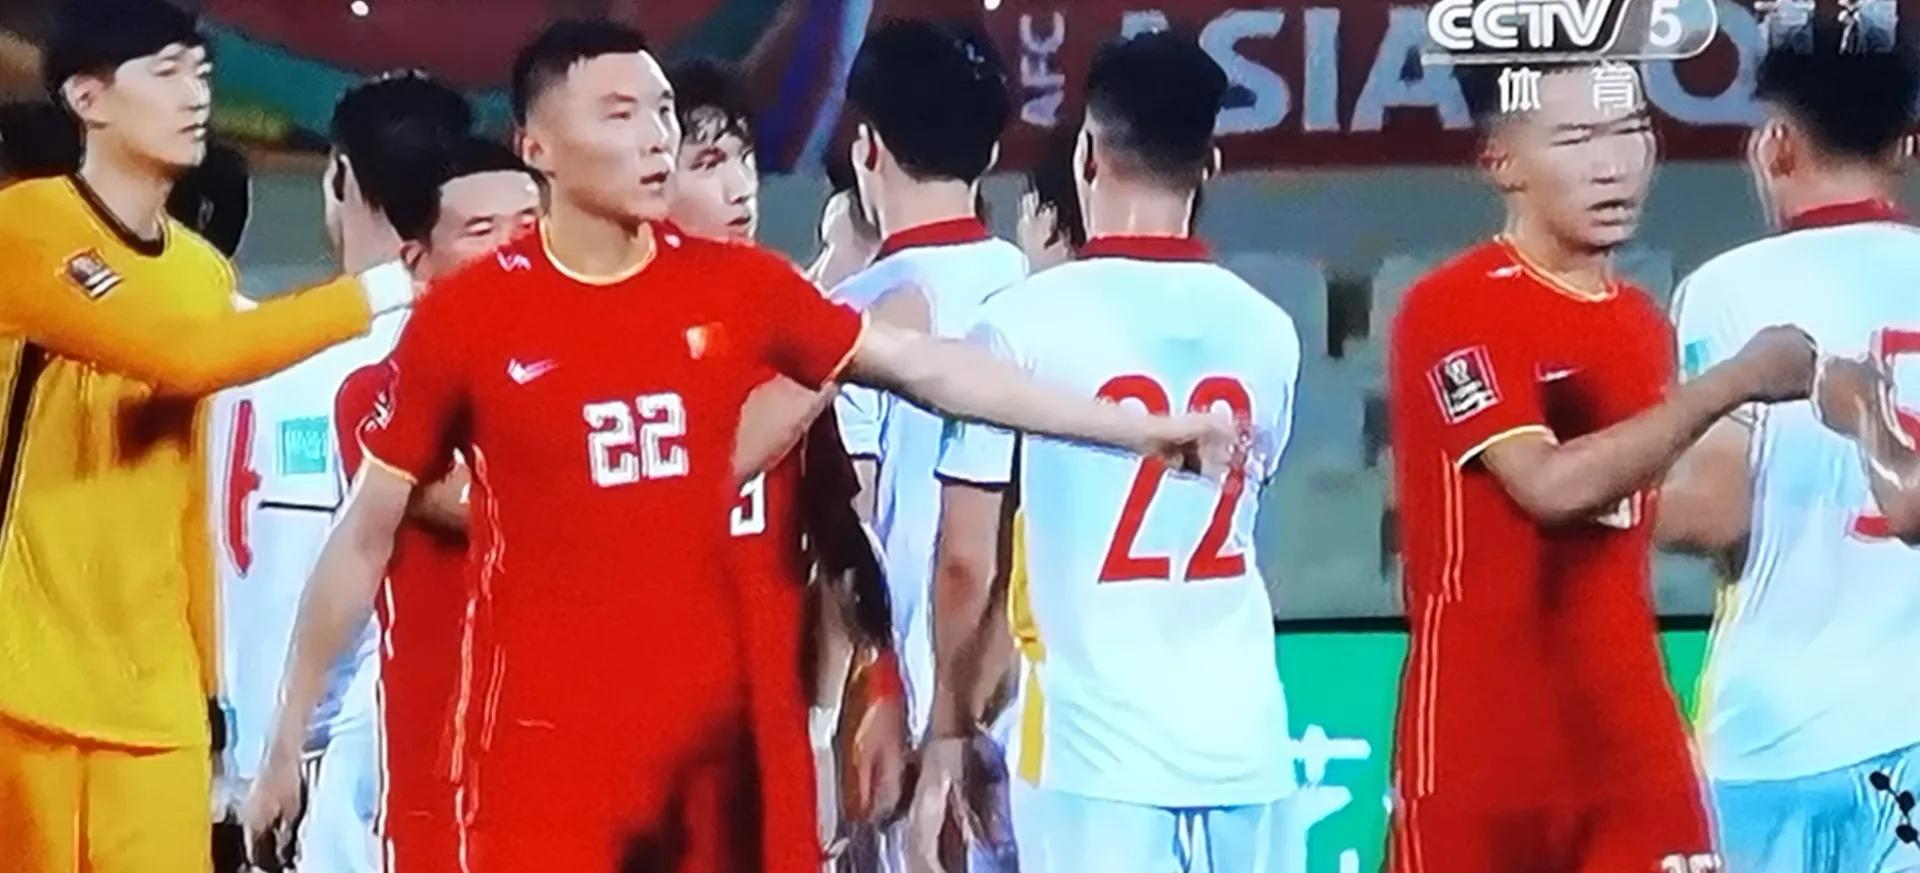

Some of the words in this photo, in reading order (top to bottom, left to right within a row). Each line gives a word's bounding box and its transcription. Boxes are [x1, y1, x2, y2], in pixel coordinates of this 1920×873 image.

[1019, 11, 1065, 128] AFC
[1119, 6, 1475, 133] SIA
[582, 392, 689, 487] 22
[1096, 374, 1253, 582] 22
